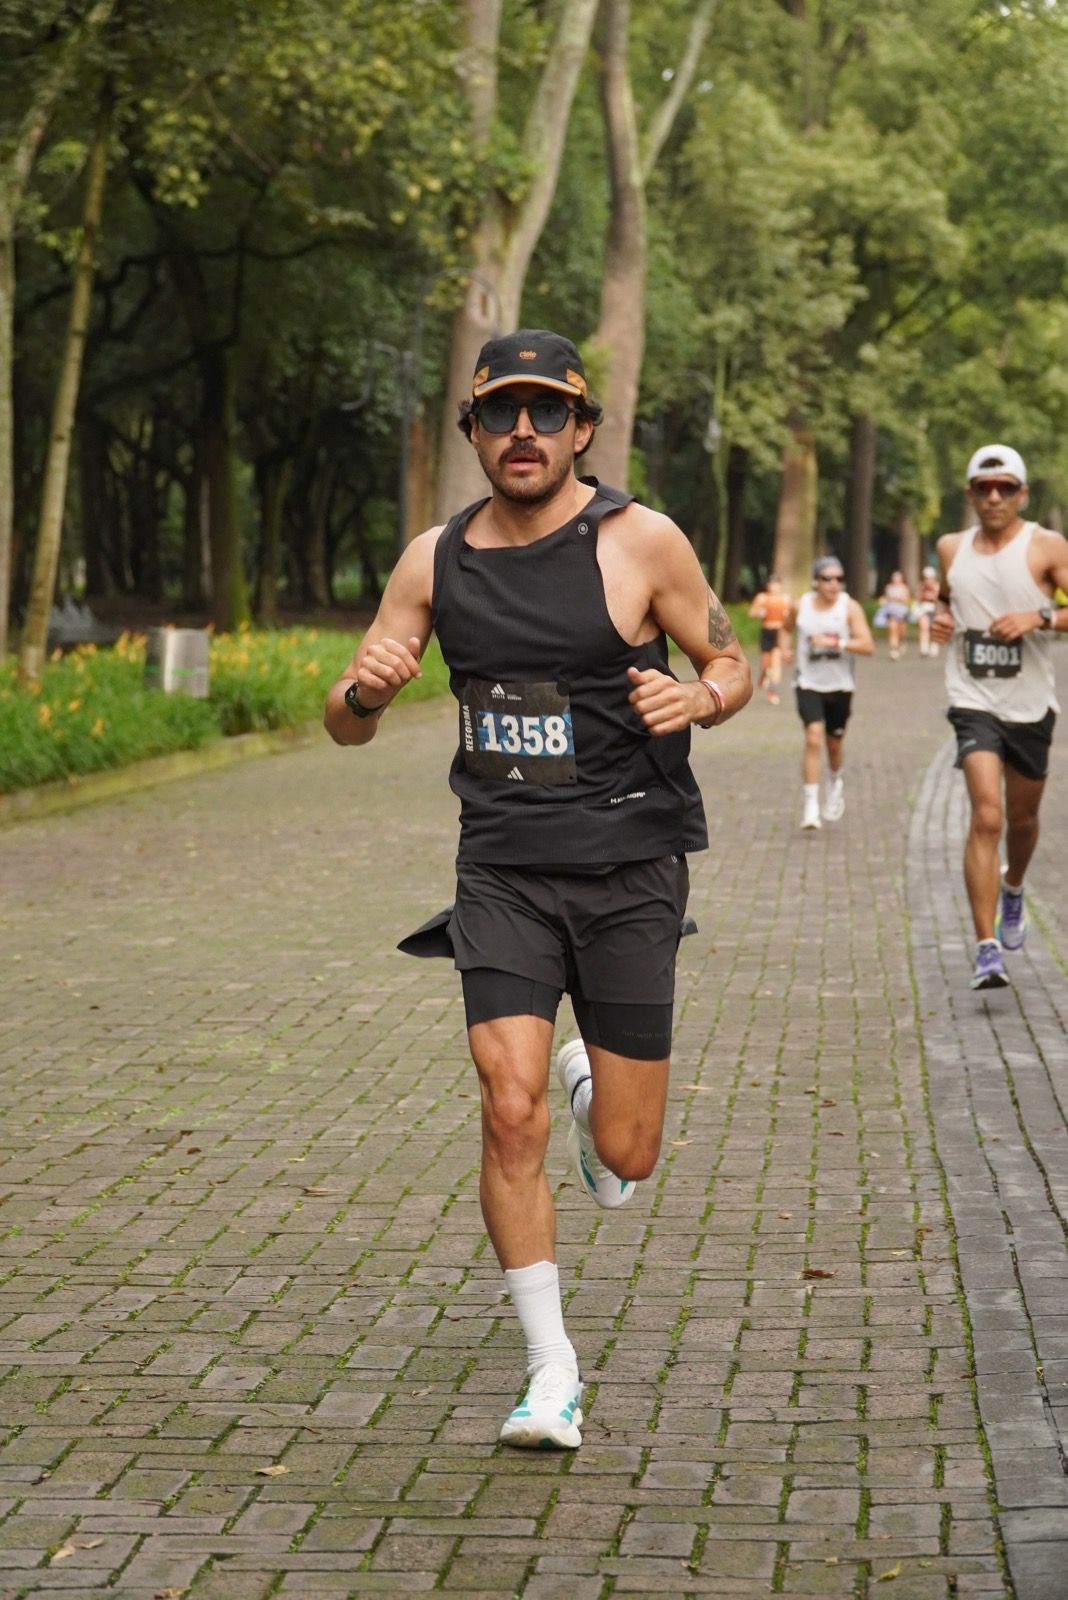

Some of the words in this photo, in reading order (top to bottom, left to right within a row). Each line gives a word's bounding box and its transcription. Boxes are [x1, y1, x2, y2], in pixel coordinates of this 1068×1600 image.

[974, 643, 1020, 666] 5001
[462, 704, 474, 752] REFORMA
[482, 712, 568, 756] 1358
